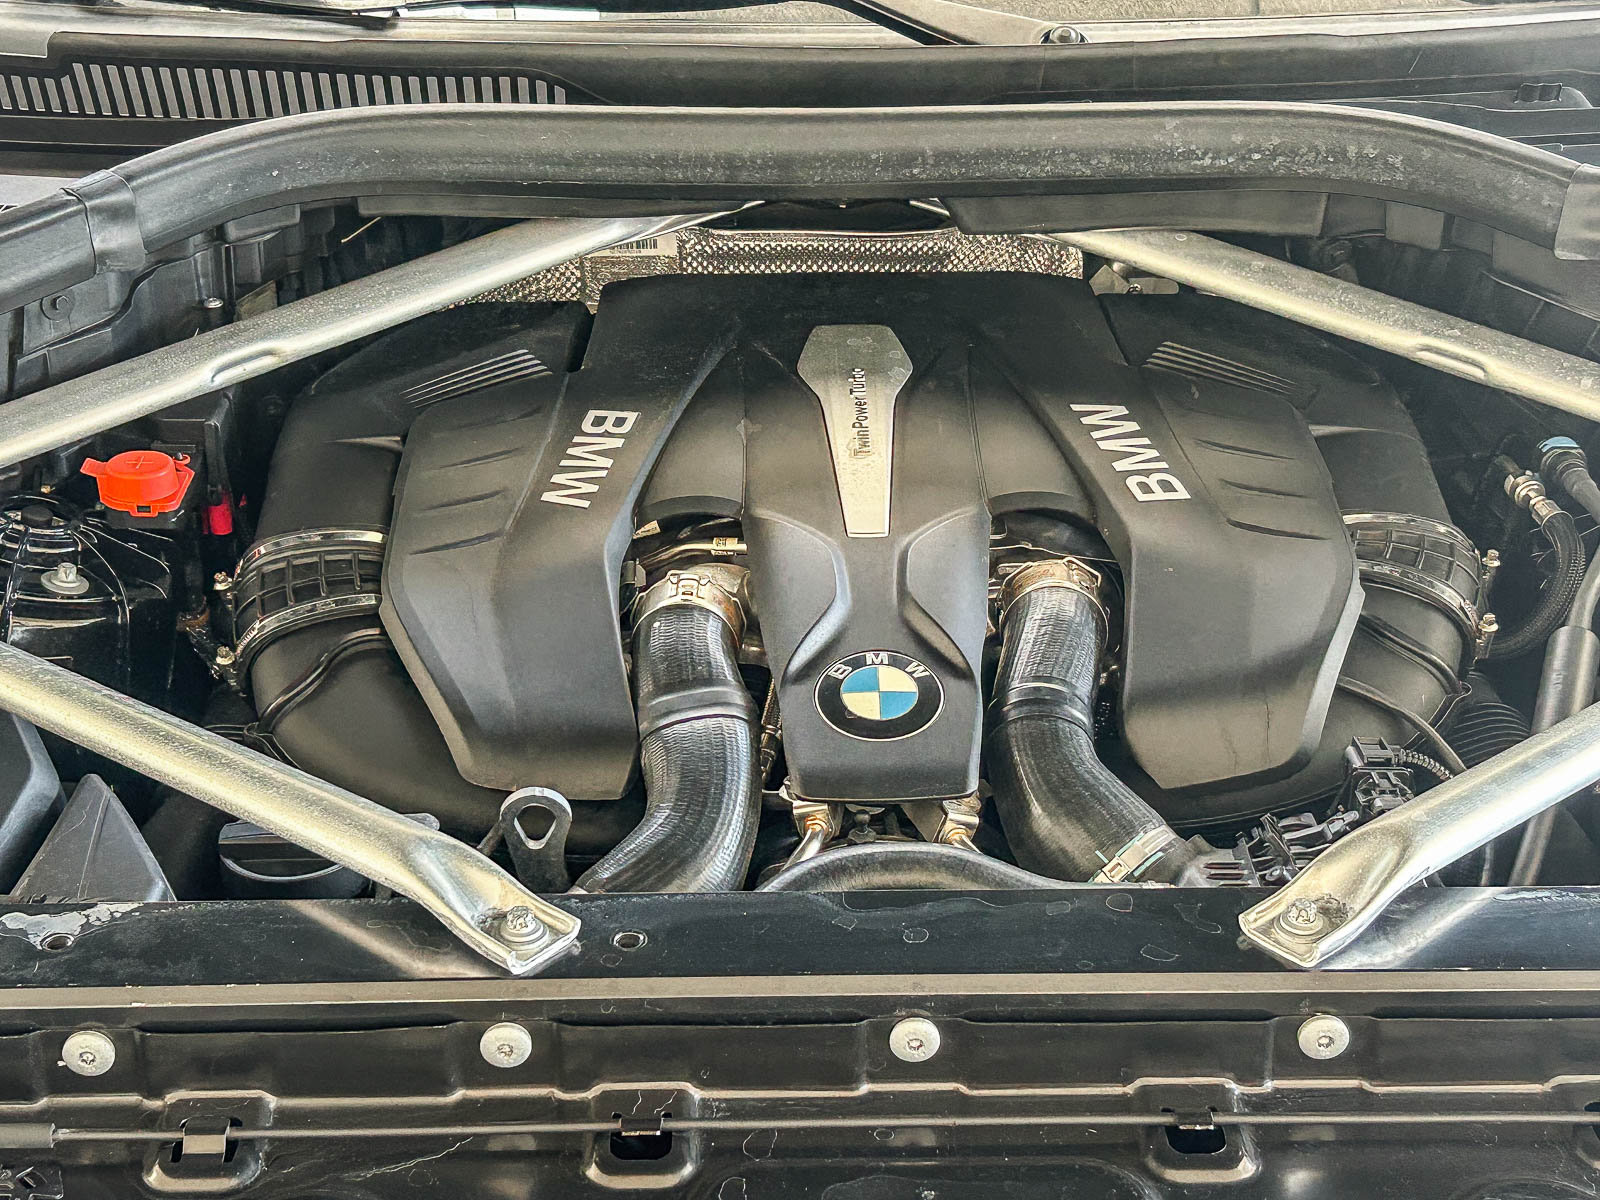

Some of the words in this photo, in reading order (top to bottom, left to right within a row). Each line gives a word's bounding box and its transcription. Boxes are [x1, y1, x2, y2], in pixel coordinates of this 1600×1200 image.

[540, 409, 641, 509] BMW
[1069, 404, 1191, 502] BMW
[828, 652, 930, 680] BMW
